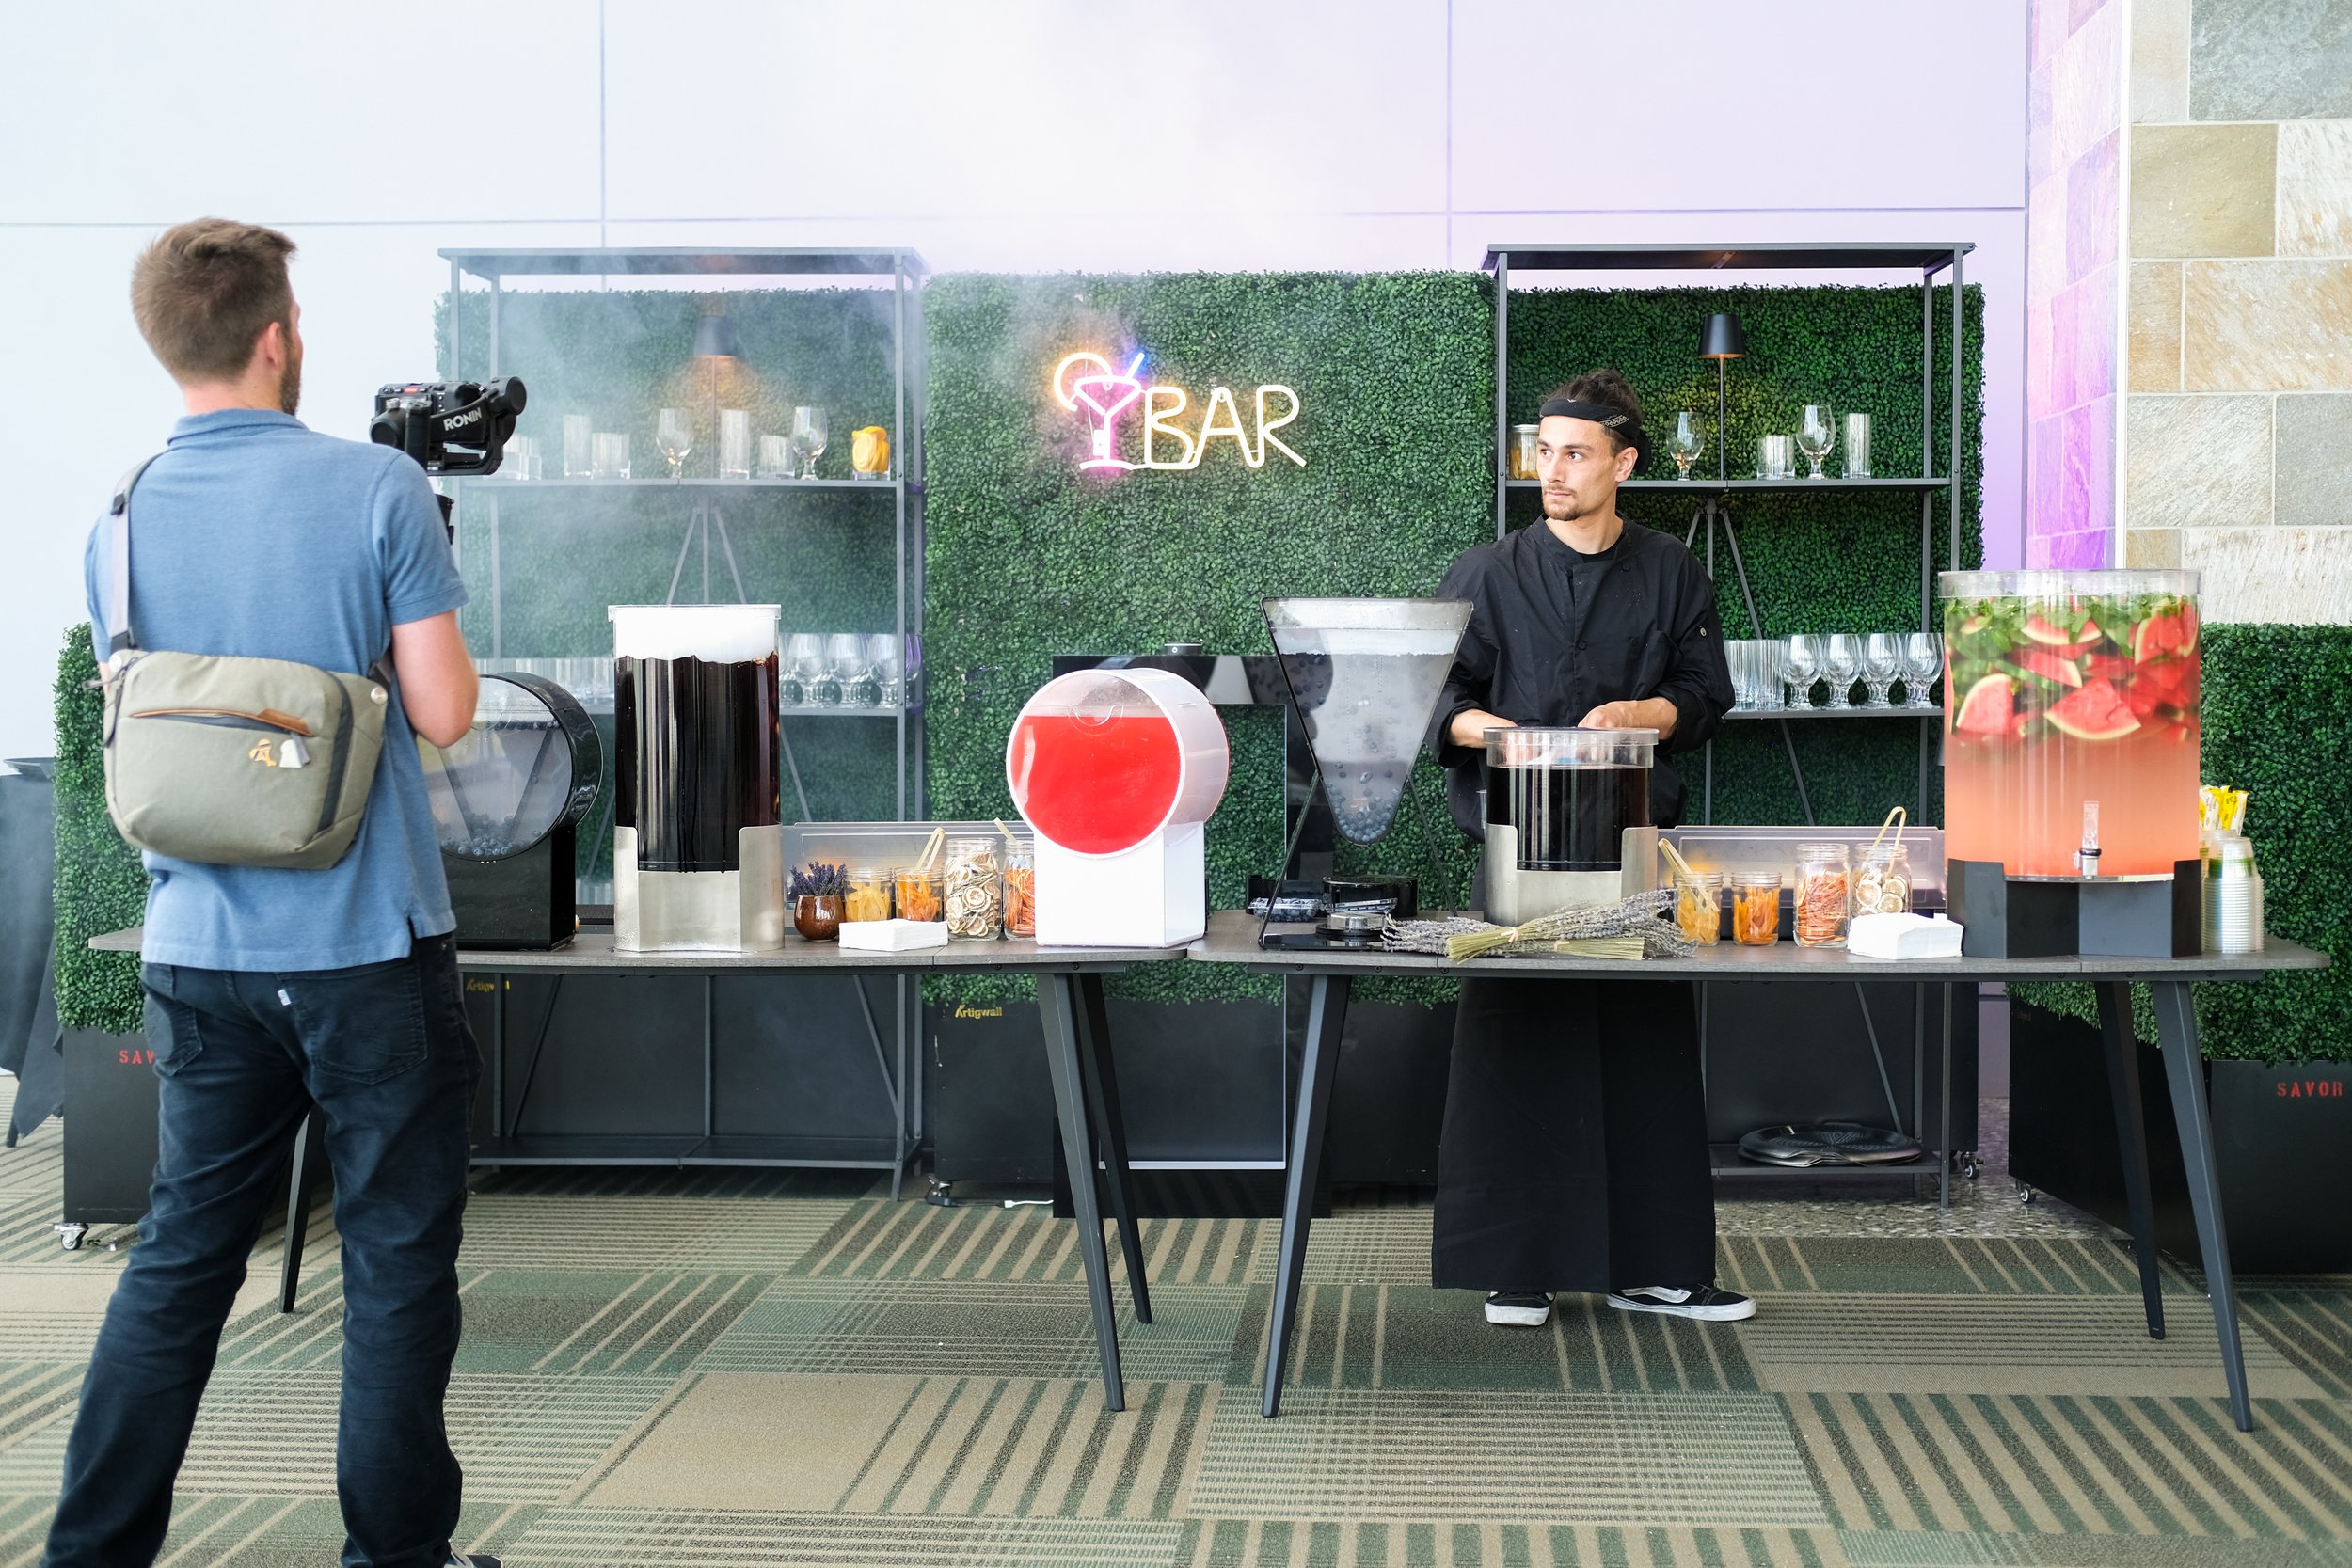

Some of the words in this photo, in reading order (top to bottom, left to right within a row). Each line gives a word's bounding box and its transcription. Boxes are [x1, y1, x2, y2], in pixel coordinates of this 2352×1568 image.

[443, 406, 482, 431] RONIN
[1145, 384, 1307, 469] BAR
[954, 1003, 1003, 1019] Artigwall
[119, 1049, 155, 1064] SAV
[2277, 1080, 2343, 1098] SAVOR
